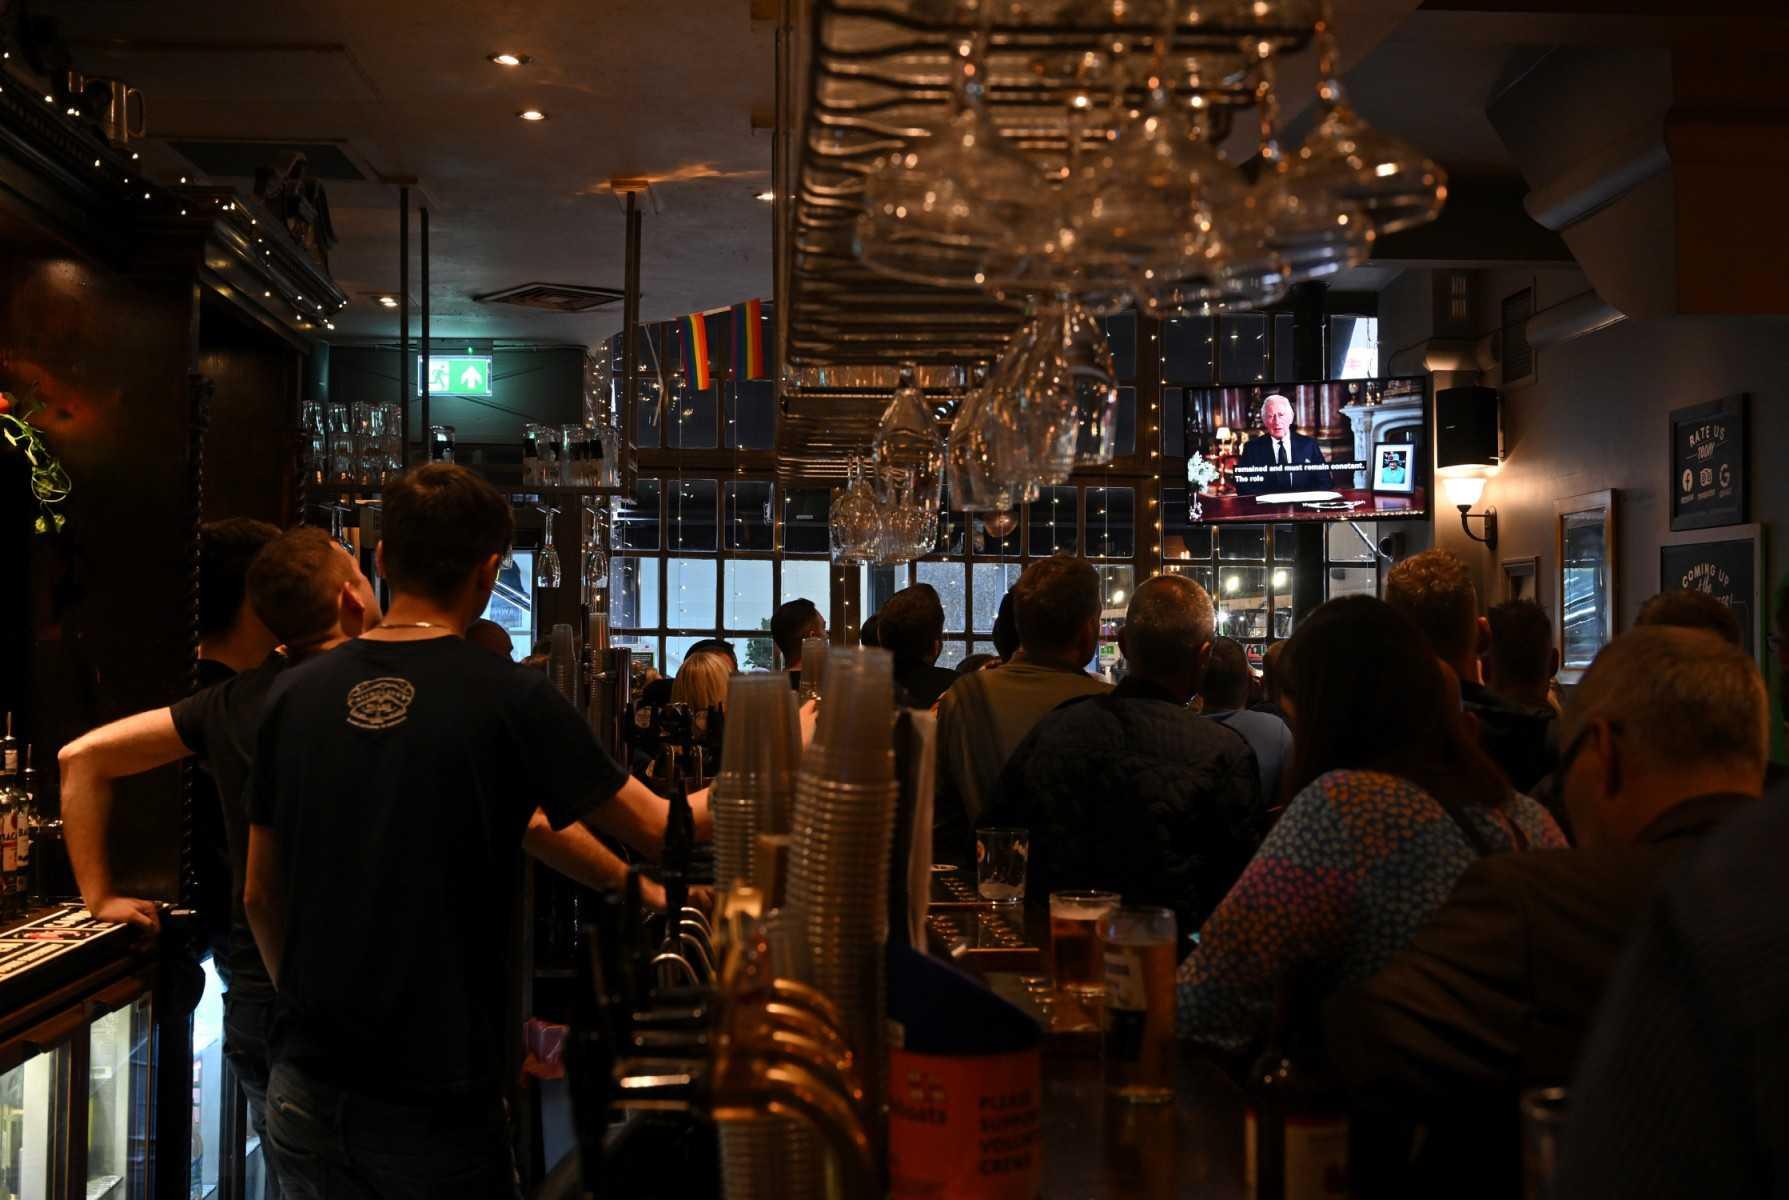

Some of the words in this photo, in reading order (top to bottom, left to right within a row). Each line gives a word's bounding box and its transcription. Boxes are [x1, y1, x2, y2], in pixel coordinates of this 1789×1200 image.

[1689, 424, 1711, 448] RATE
[1713, 423, 1726, 441] US
[1234, 465, 1268, 473] remained
[1269, 464, 1283, 472] and
[1284, 464, 1303, 472] must
[1304, 462, 1330, 471] remain
[1331, 461, 1365, 470] constant.
[1234, 475, 1248, 483] The
[1682, 563, 1717, 589] COMING
